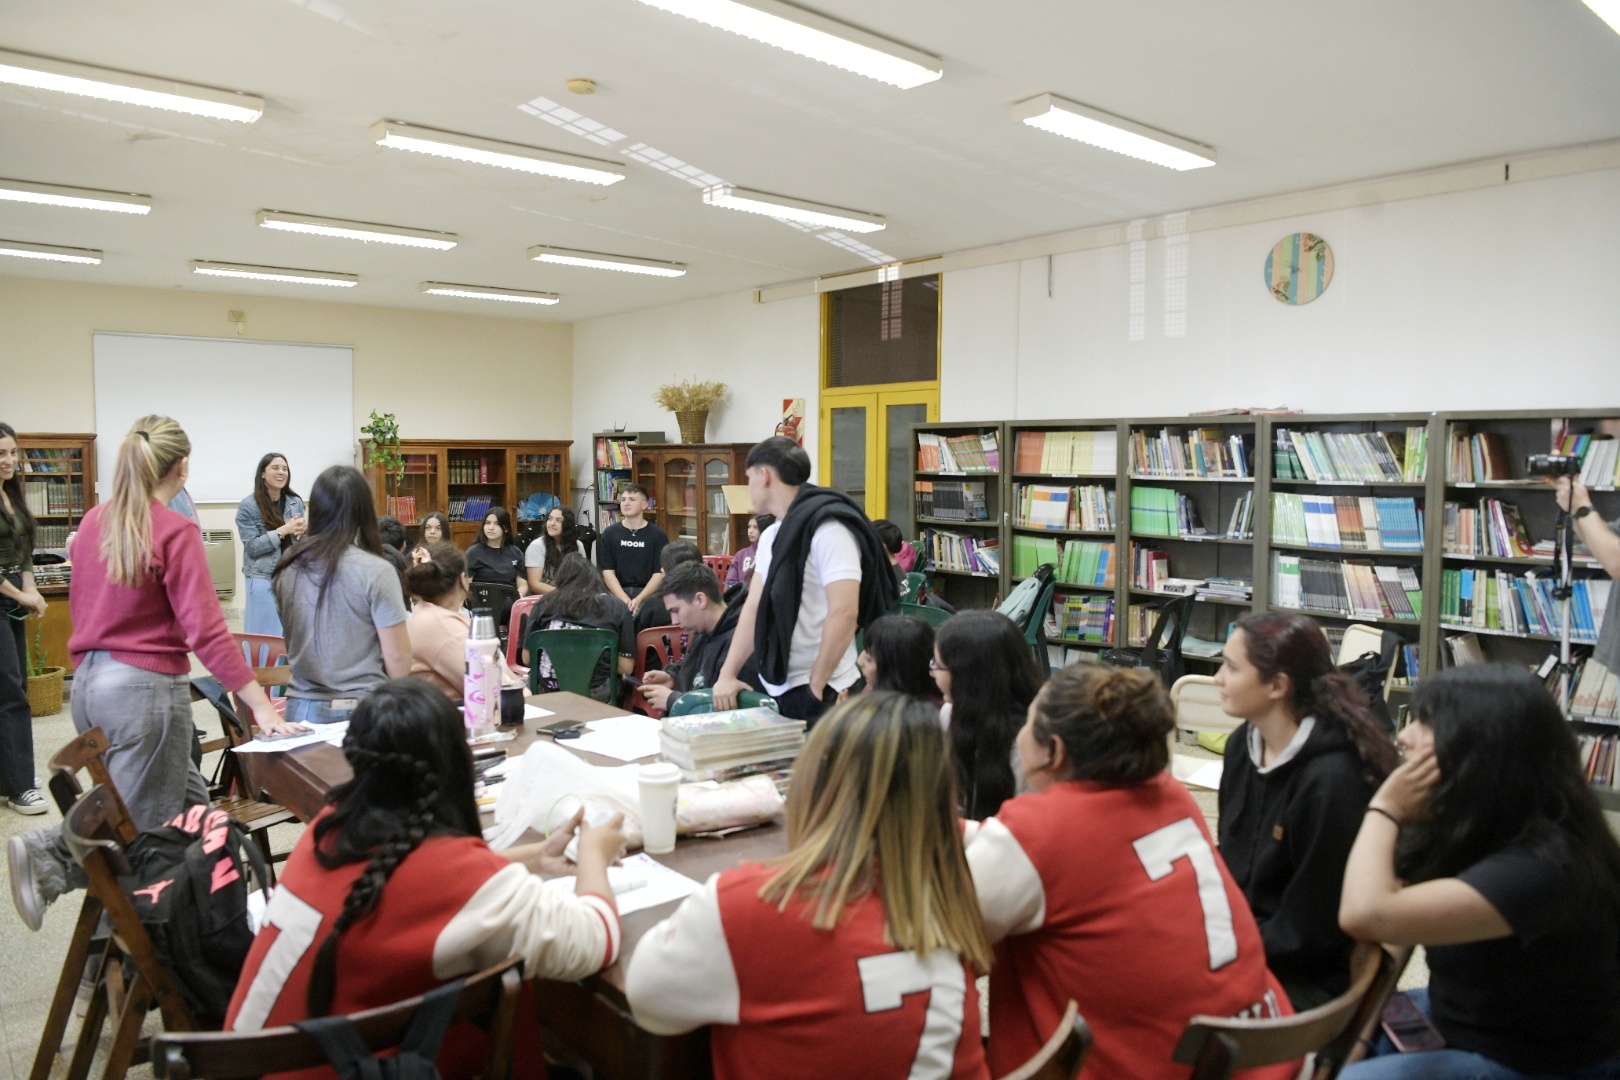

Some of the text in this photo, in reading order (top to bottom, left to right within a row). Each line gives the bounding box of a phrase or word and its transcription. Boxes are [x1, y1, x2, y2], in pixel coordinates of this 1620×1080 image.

[620, 539, 645, 548] MOON
[234, 882, 324, 1031] 7
[1132, 816, 1238, 971] 7
[857, 947, 966, 1080] 7
